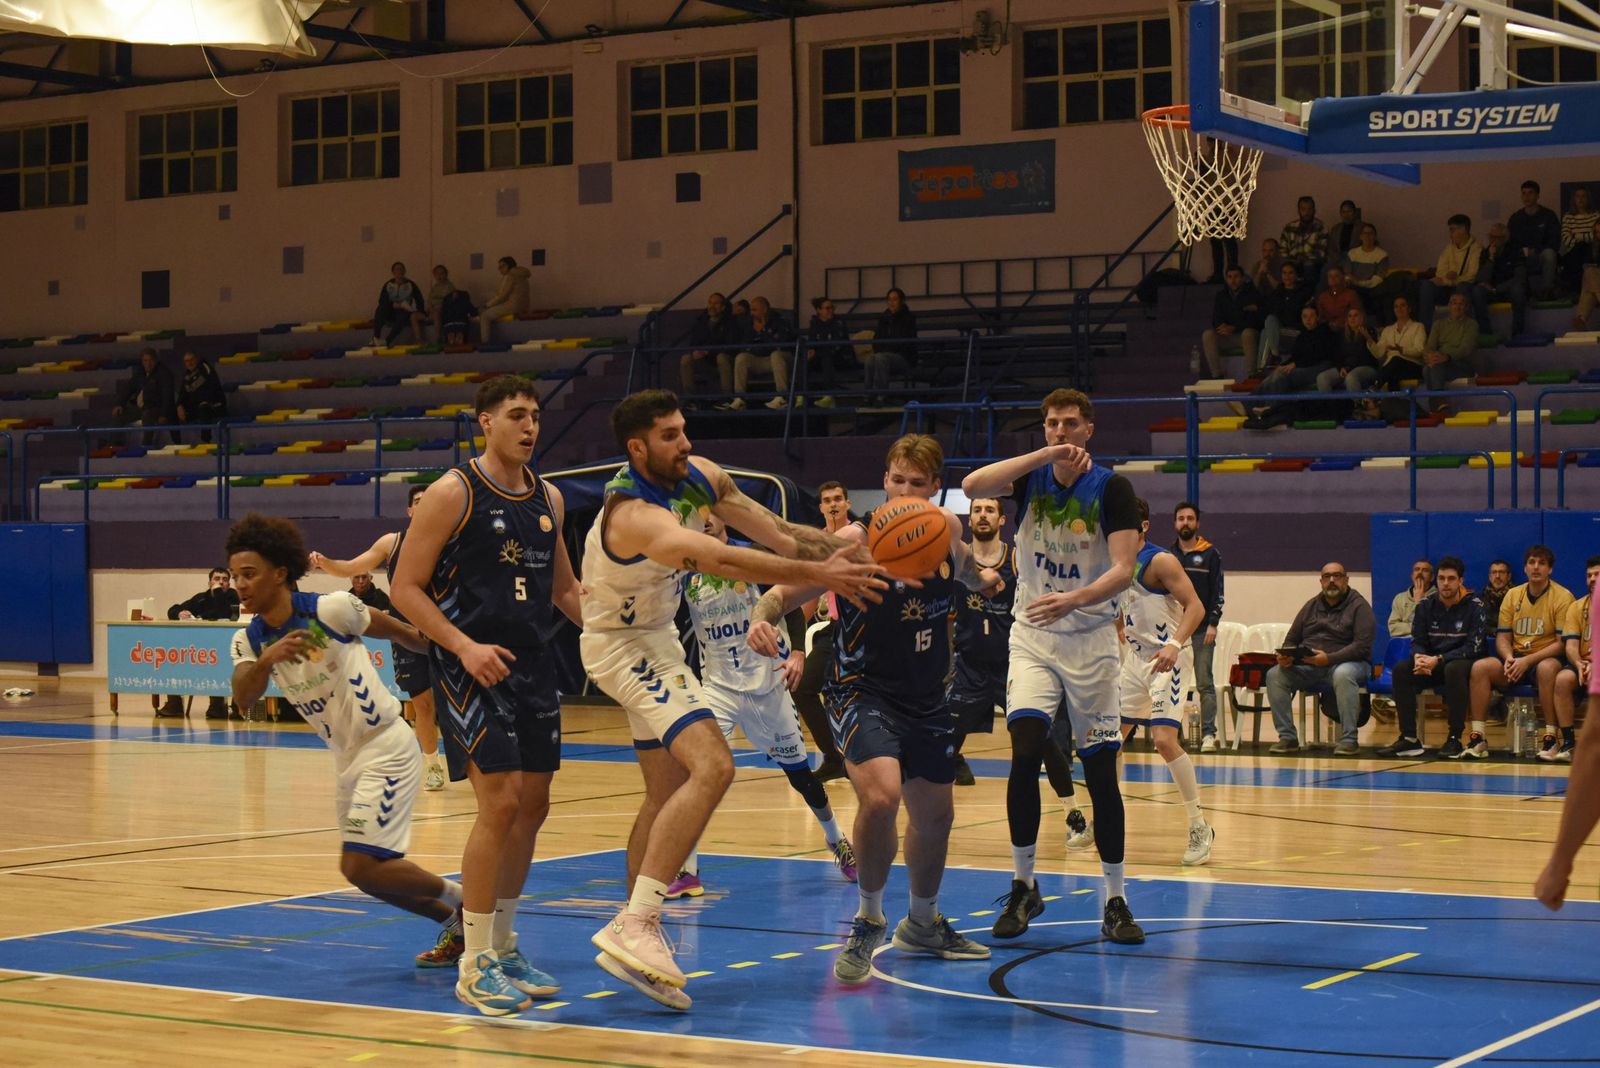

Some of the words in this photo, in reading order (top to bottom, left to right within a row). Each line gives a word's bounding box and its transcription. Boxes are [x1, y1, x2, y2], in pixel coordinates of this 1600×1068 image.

[1369, 109, 1453, 130] SPORT
[1454, 103, 1560, 134] SYSTEM
[515, 576, 527, 600] 5
[983, 618, 990, 635] 1
[914, 628, 933, 652] 15
[130, 640, 218, 670] deportes
